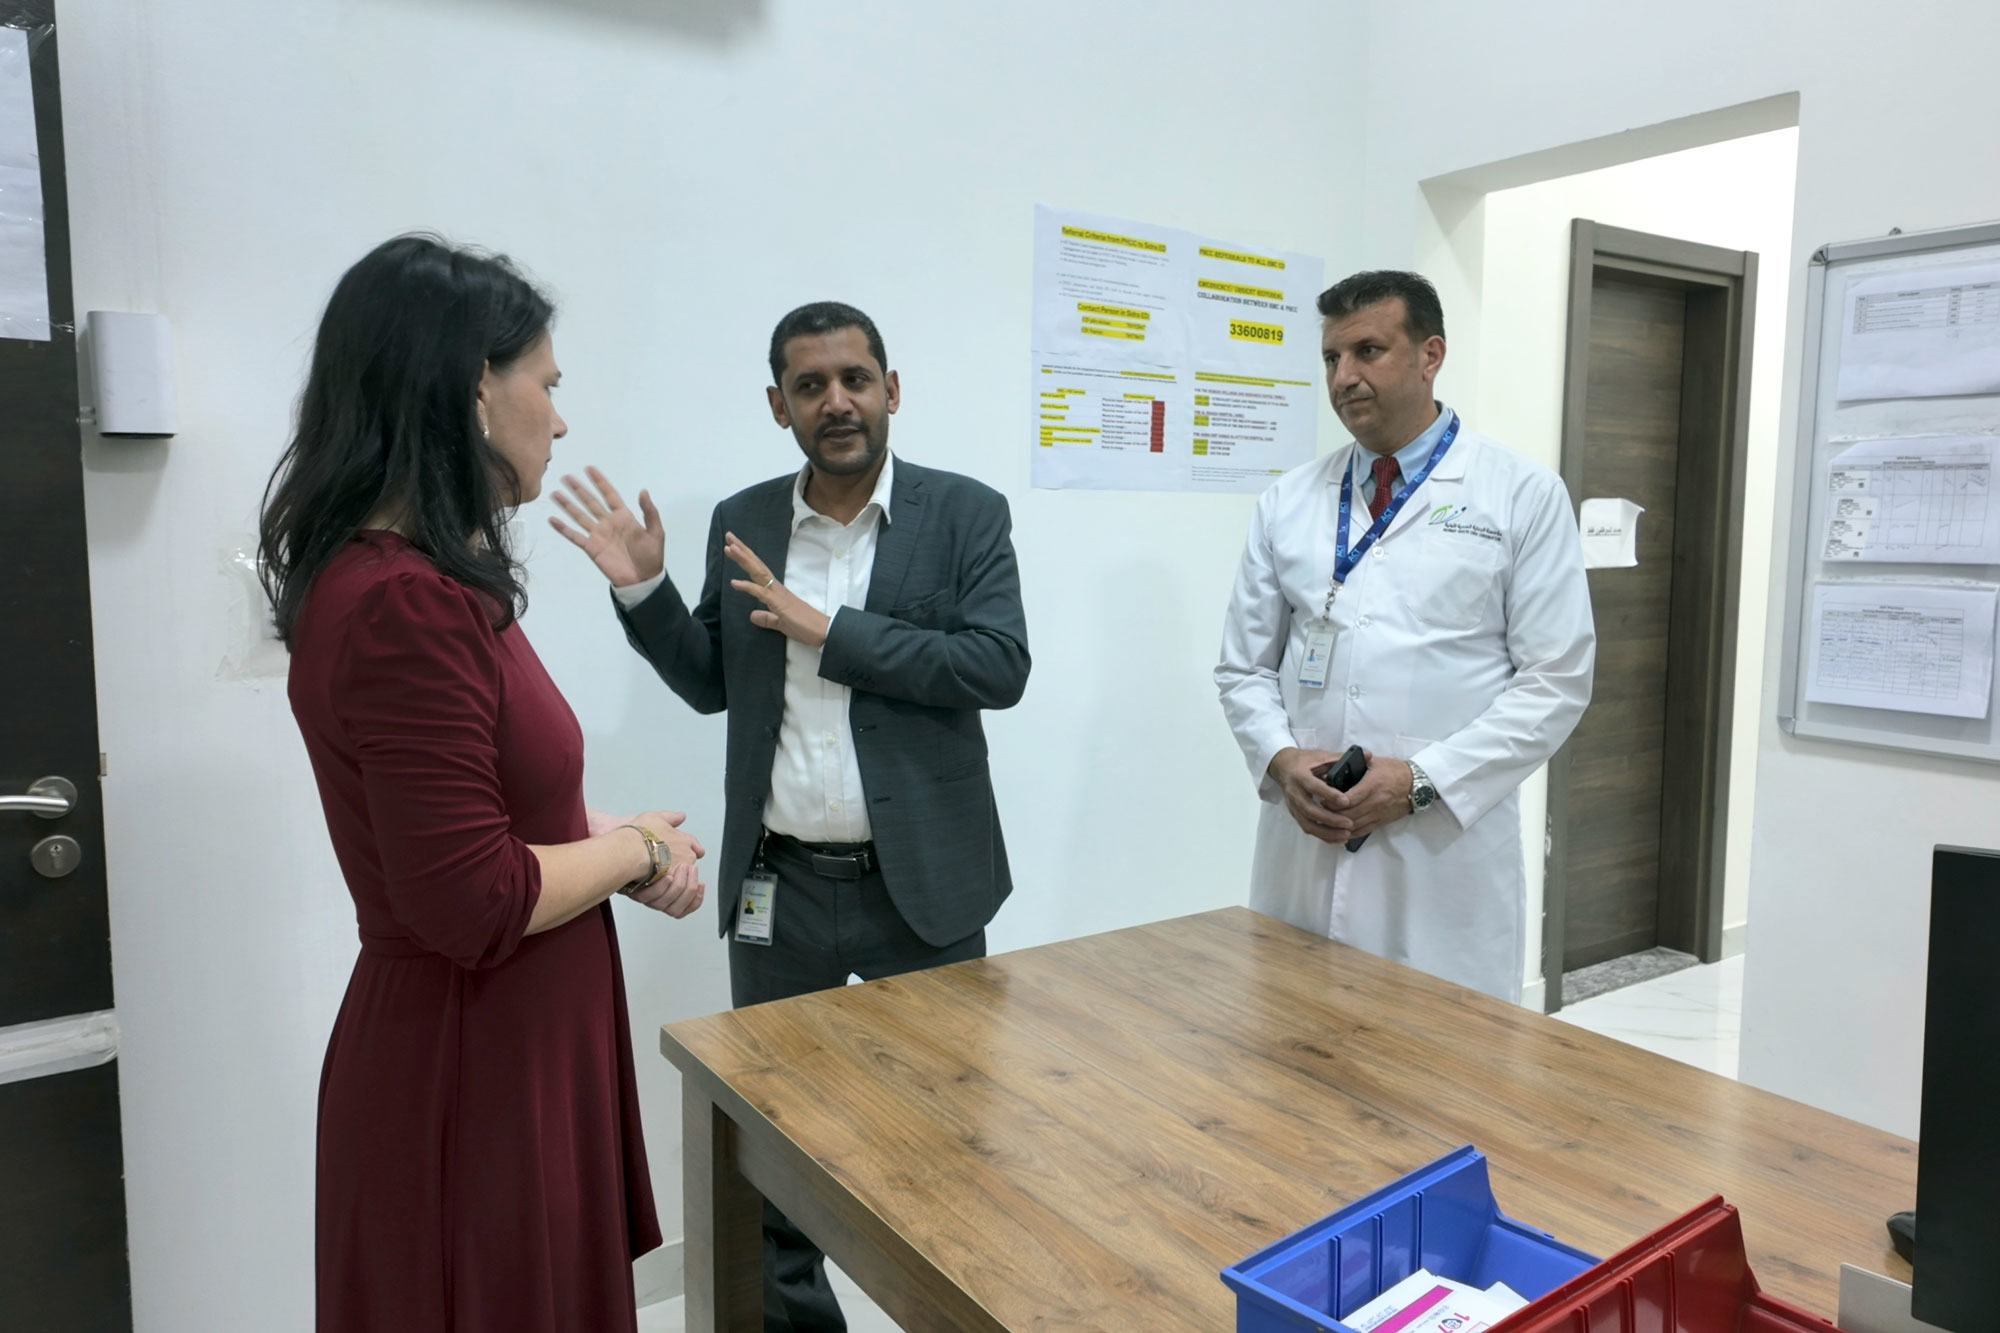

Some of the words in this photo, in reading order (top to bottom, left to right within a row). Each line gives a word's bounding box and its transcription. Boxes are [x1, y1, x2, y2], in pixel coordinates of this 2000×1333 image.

[1197, 291, 1242, 304] COLLABORATION
[1243, 298, 1268, 308] BETWEEN
[1229, 323, 1284, 342] 33600819
